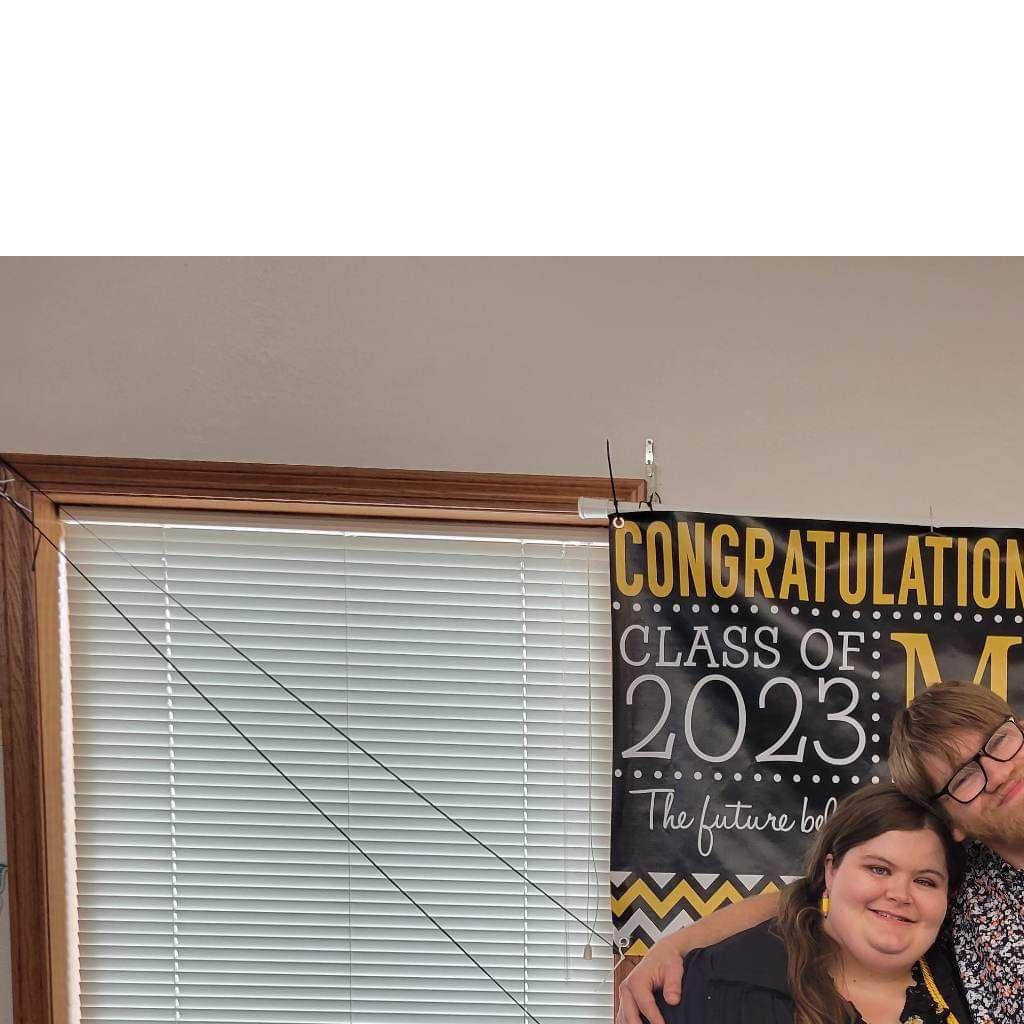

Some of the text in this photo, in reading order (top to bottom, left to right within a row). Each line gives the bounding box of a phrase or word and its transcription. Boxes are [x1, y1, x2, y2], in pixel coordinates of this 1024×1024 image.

[619, 624, 866, 671] CLASS OF
[621, 674, 867, 766] 2023
[628, 789, 692, 831] The
[698, 801, 796, 857] future
